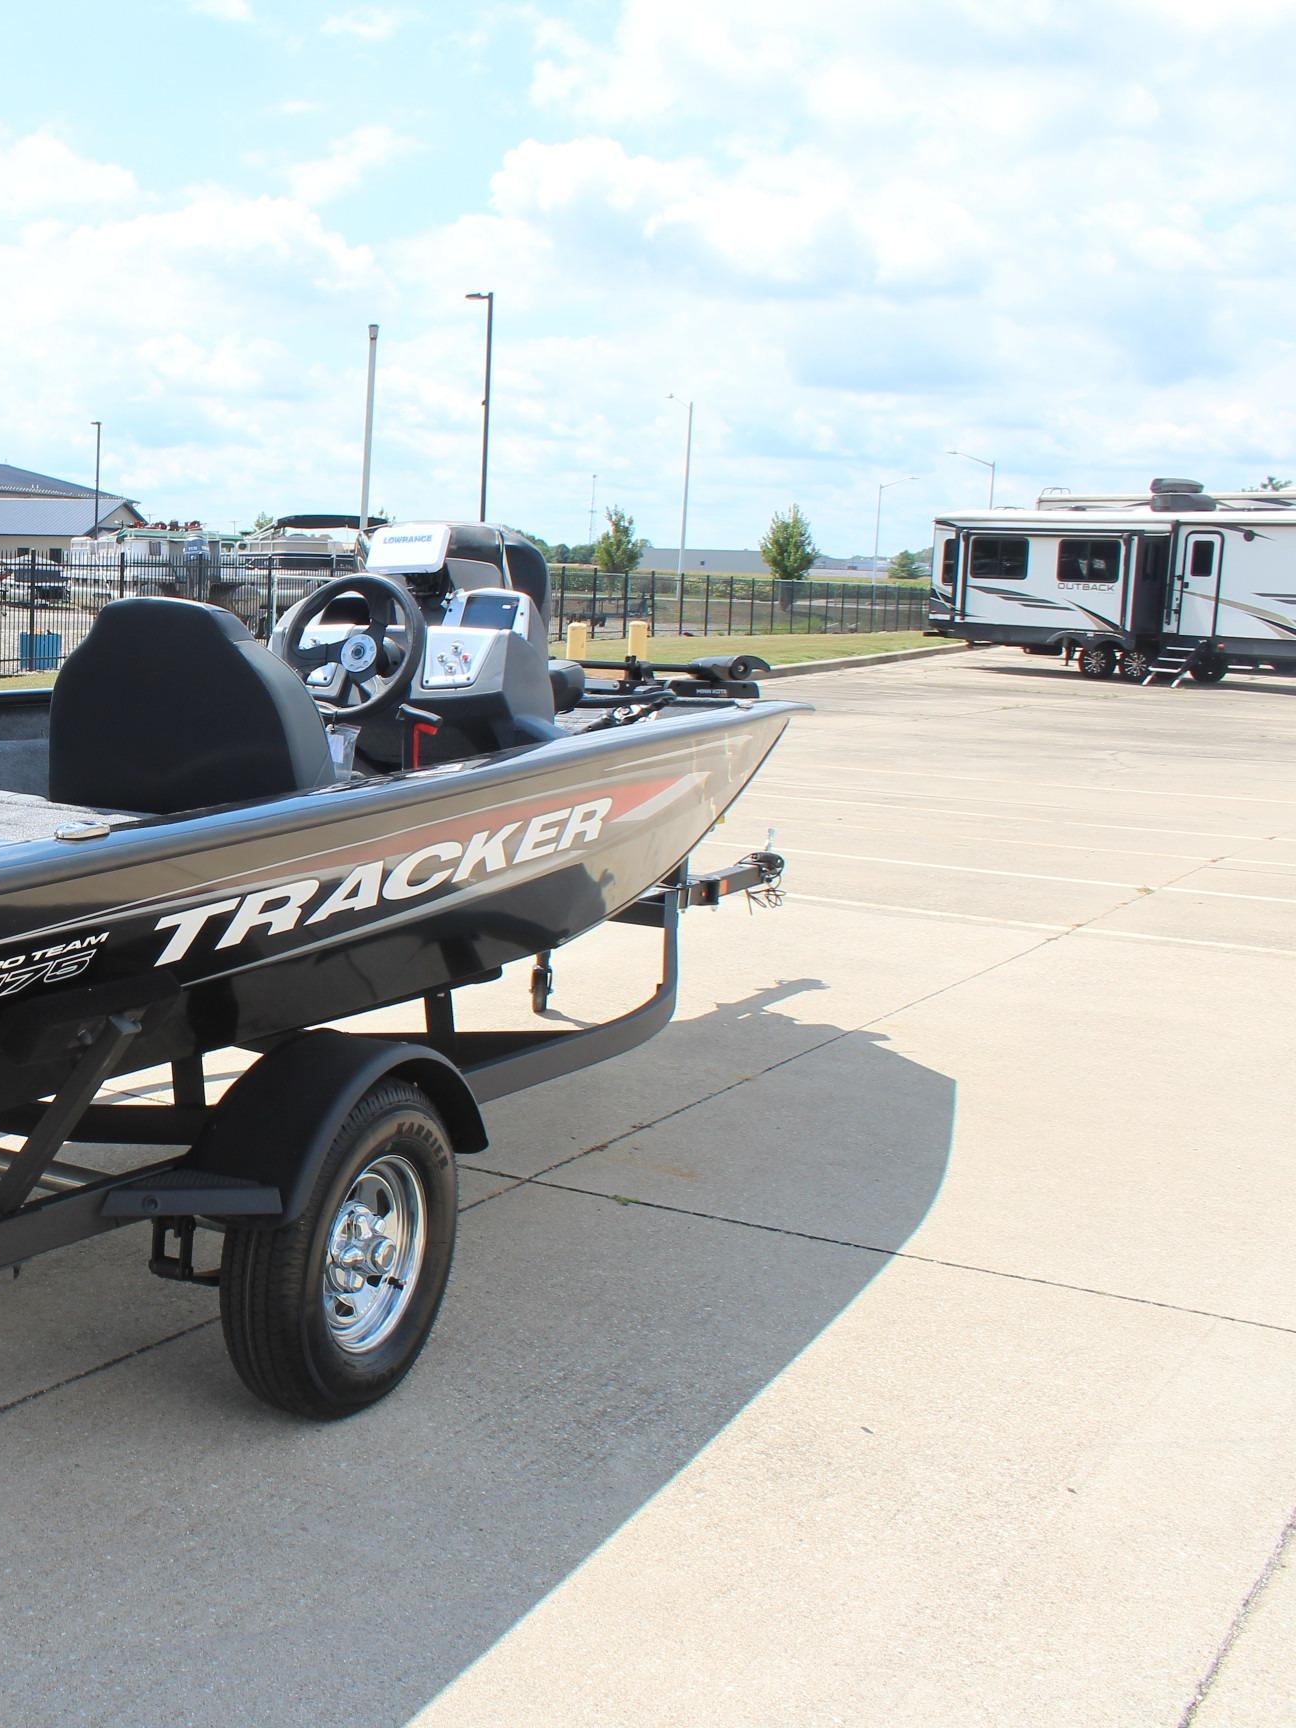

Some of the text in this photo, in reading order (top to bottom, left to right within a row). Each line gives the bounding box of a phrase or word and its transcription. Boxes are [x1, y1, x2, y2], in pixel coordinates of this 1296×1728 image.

[383, 534, 433, 544] LOWRANCE
[1057, 582, 1115, 592] OUTBACK
[153, 797, 613, 968] TRACKER
[31, 931, 110, 961] TEAM
[394, 1121, 450, 1170] KARRIER
